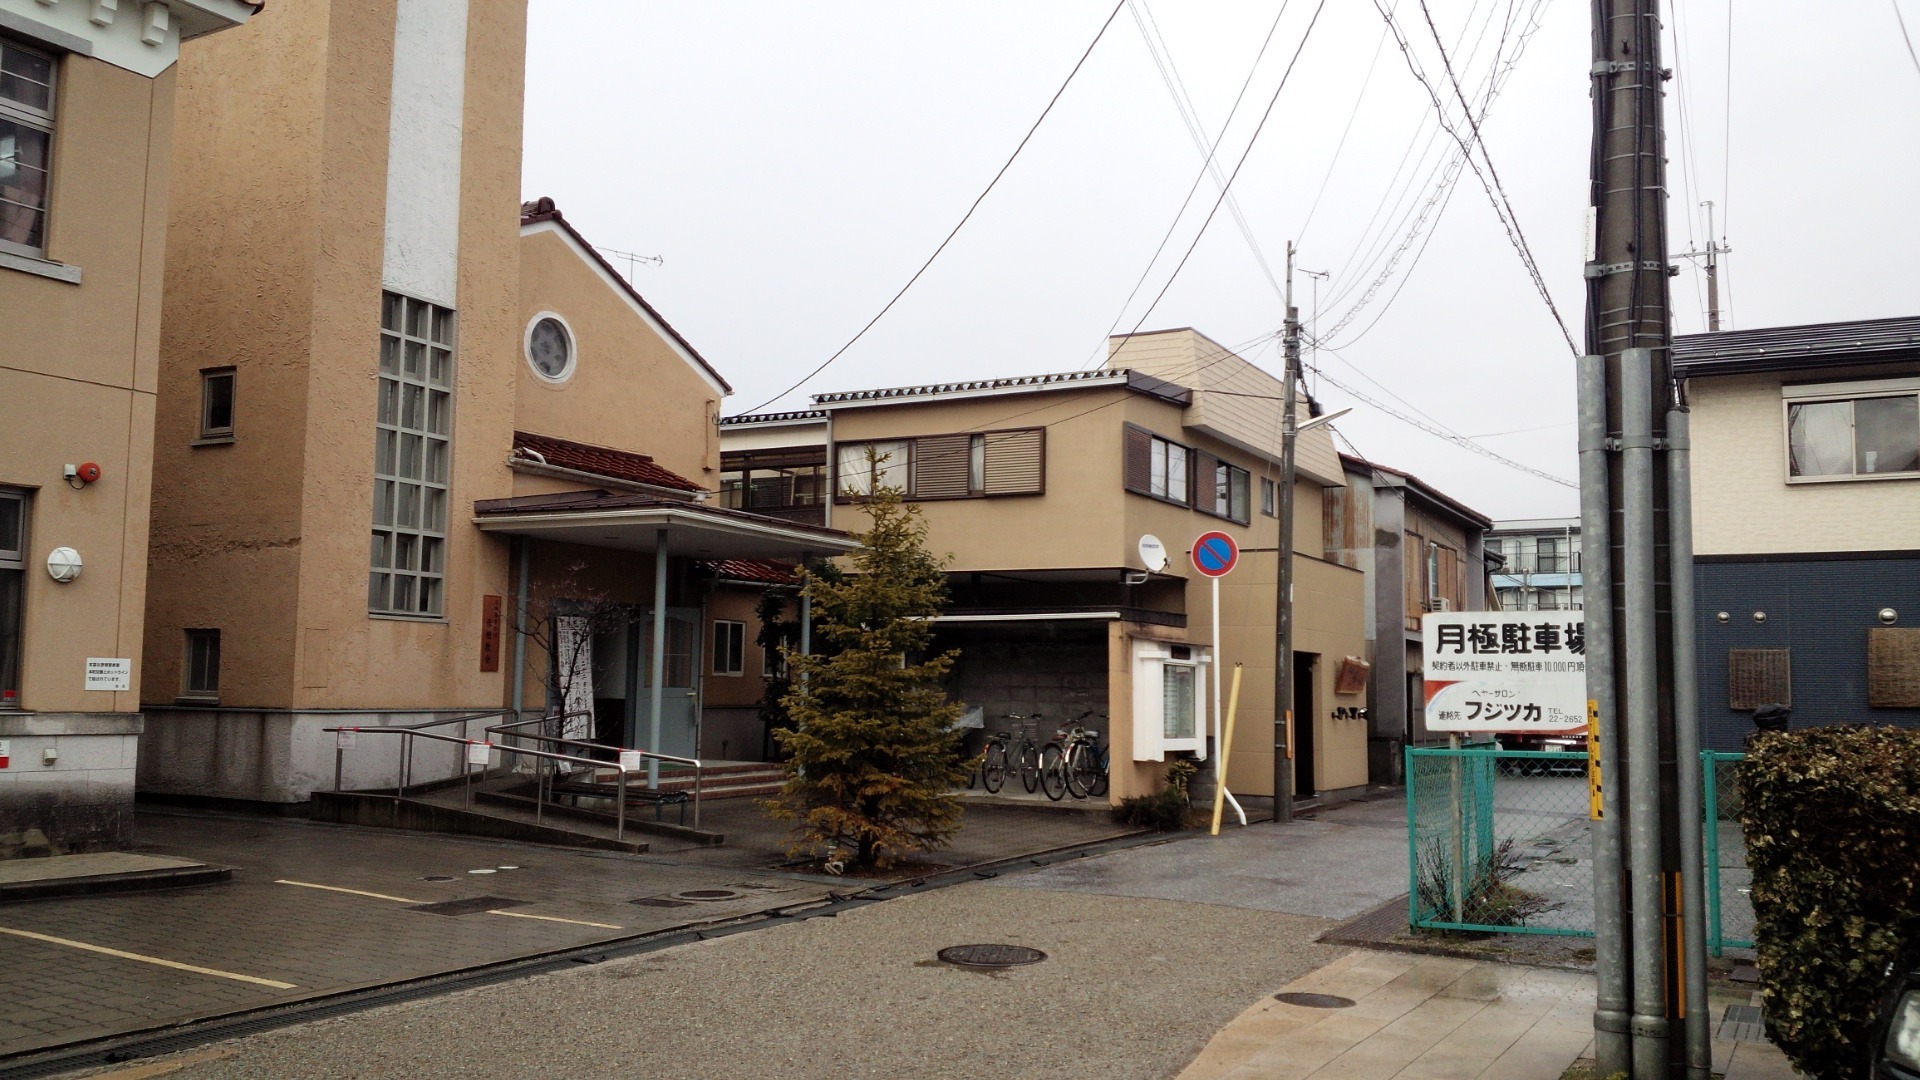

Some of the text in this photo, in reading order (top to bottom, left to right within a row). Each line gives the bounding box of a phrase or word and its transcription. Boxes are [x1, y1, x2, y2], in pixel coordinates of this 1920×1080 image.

[1437, 622, 1586, 655] 月極駐車場
[1438, 701, 1542, 722] 連絡先 フジツカ
[1549, 715, 1582, 723] 22-2652
